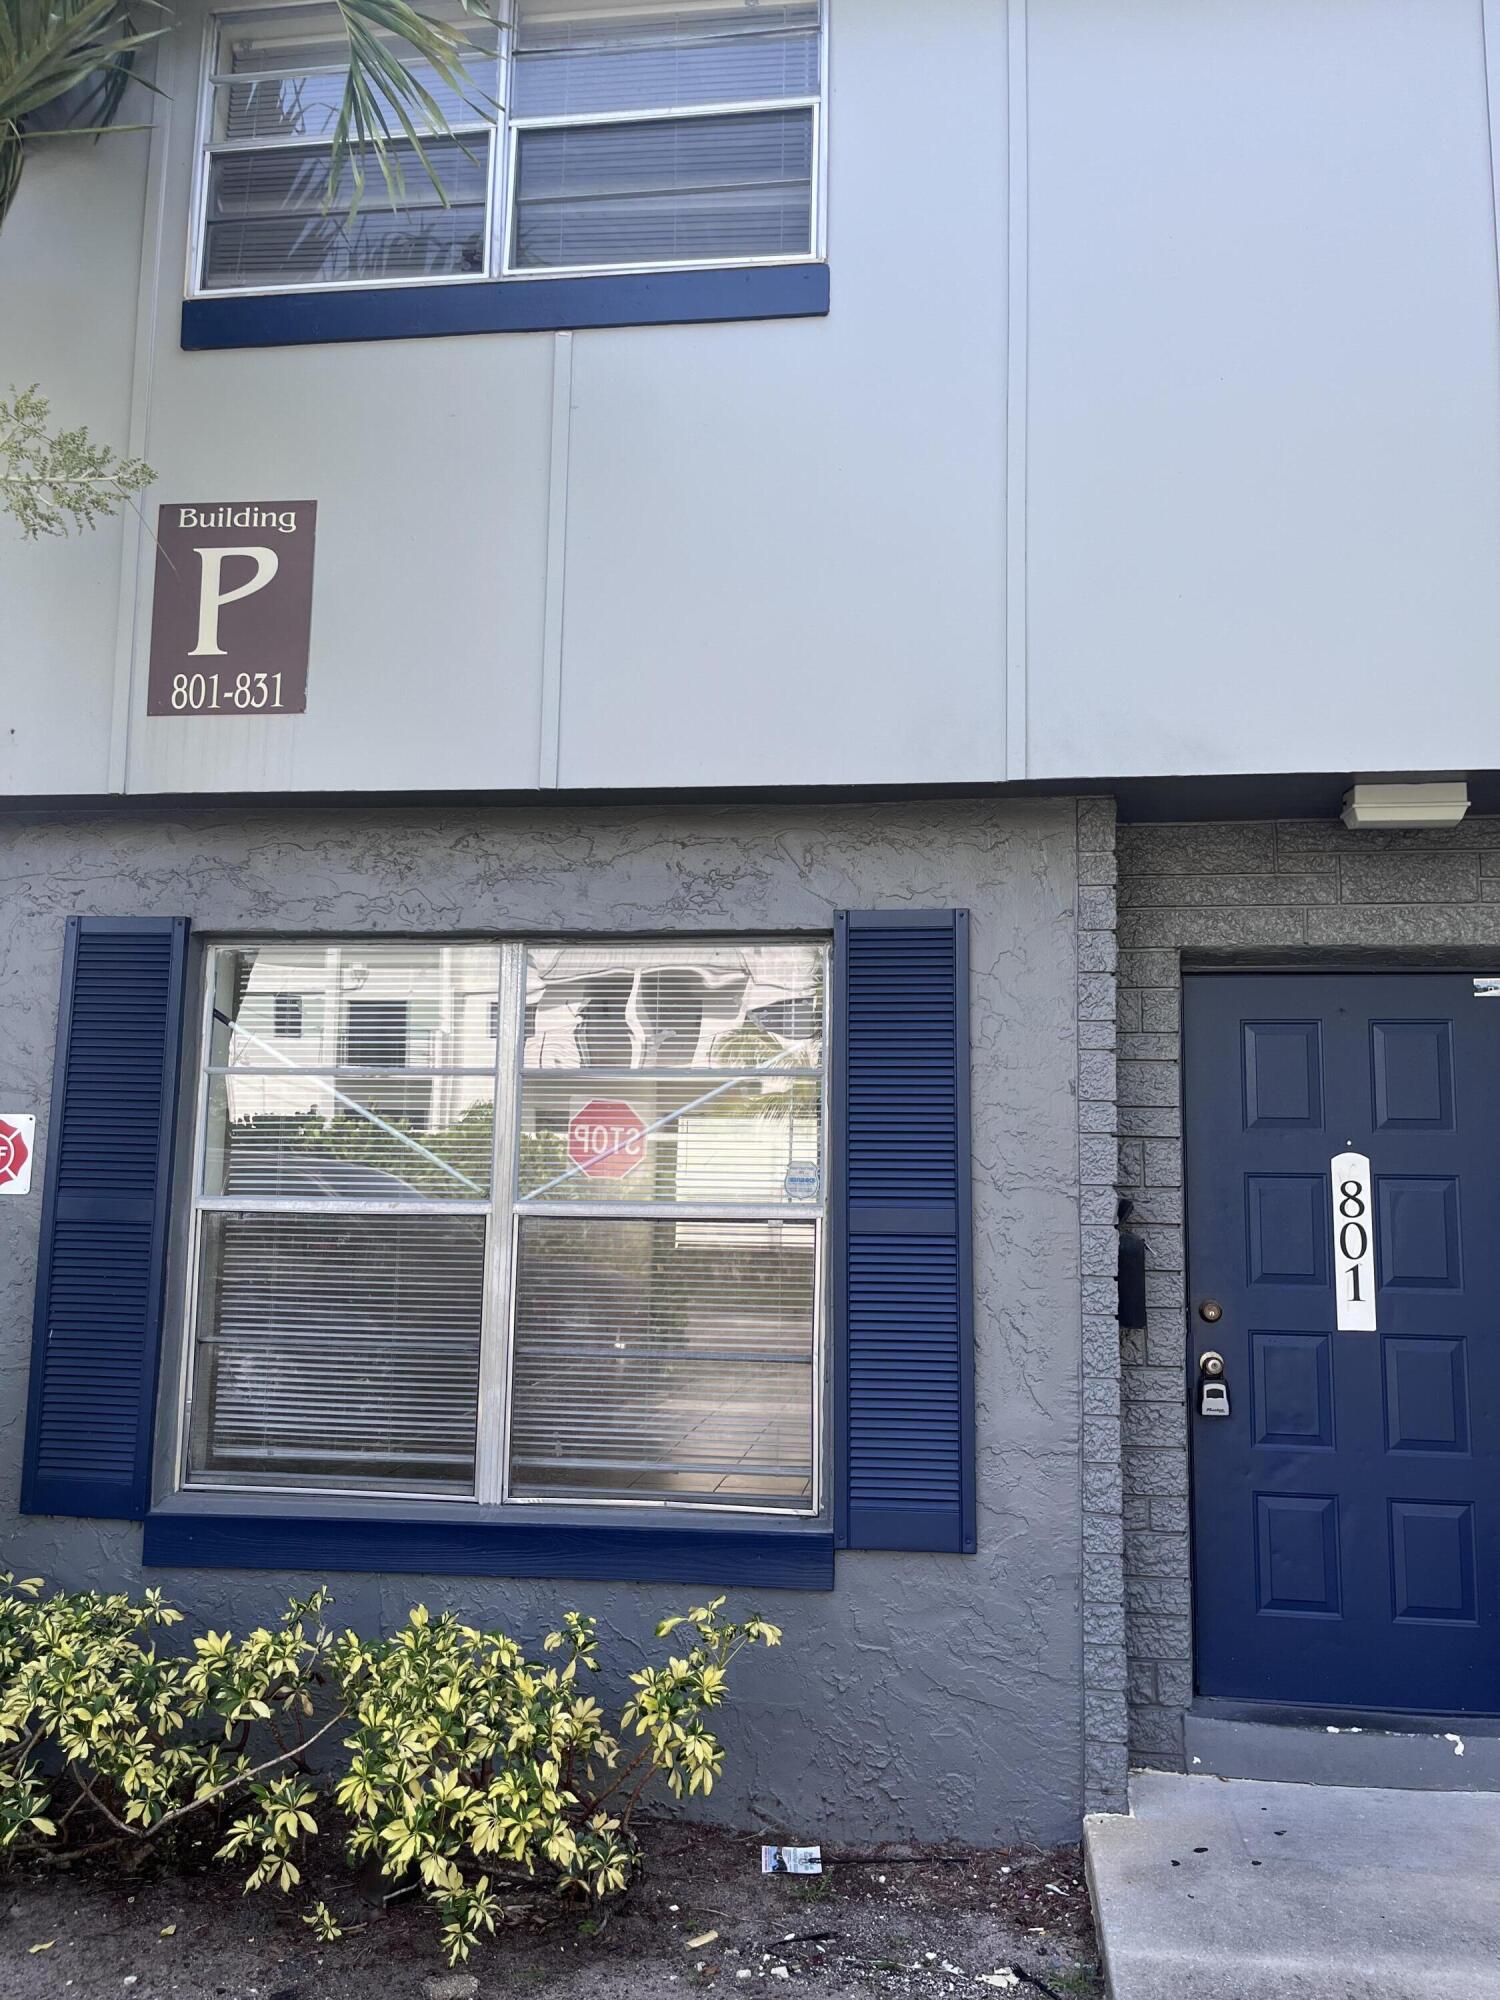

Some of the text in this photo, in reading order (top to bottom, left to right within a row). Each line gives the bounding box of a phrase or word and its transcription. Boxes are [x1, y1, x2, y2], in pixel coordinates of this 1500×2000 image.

[178, 507, 297, 533] Building
[188, 546, 279, 656] P
[171, 672, 284, 710] 801-831
[1339, 1180, 1368, 1302] 801
